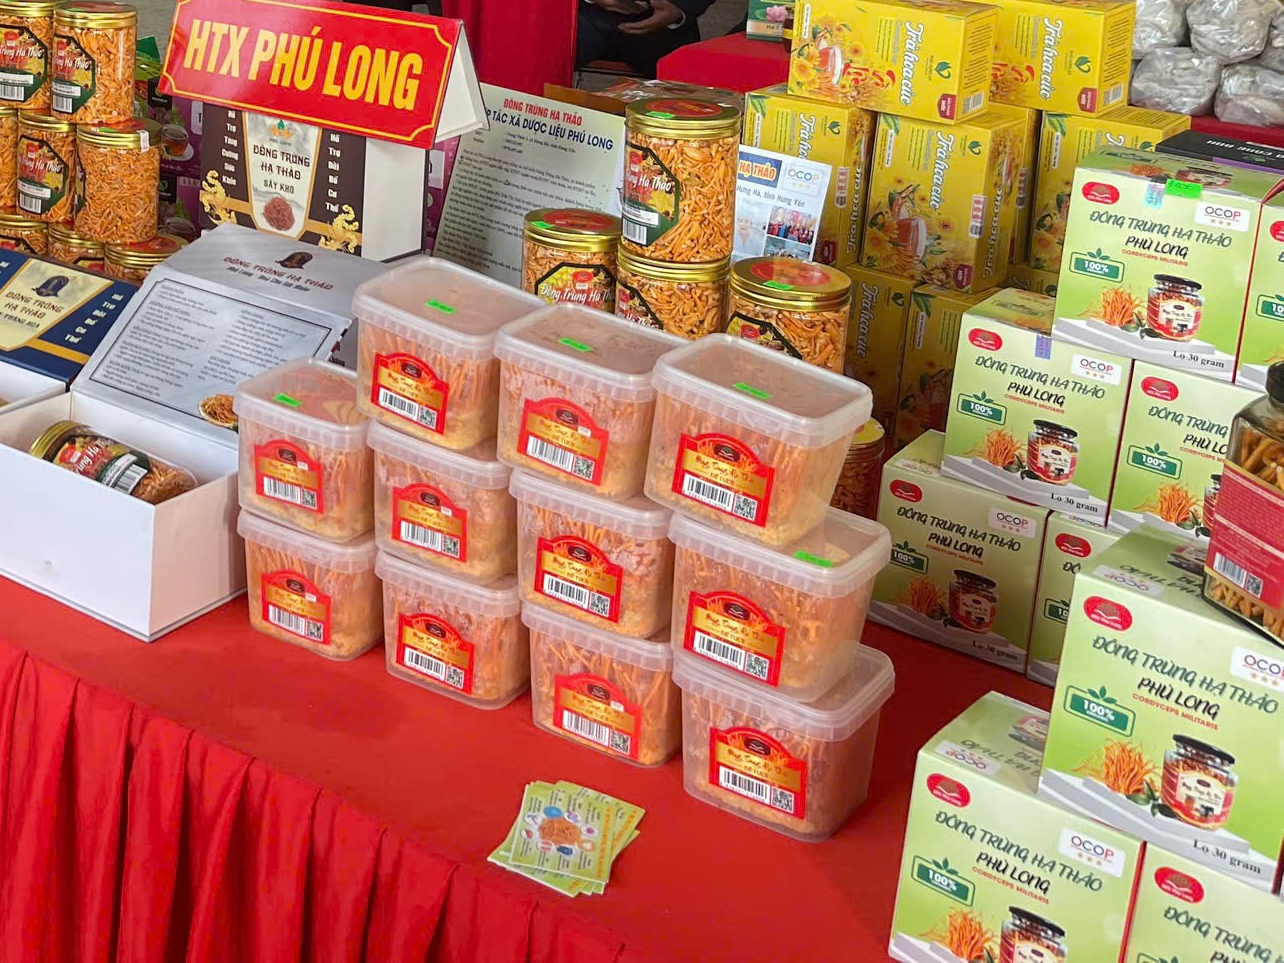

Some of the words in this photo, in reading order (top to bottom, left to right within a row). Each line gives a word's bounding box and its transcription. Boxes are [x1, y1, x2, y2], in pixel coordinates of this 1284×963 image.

[904, 20, 925, 50] Trà
[1042, 17, 1064, 46] Trà
[183, 18, 250, 78] HTX
[248, 27, 322, 91] PHÚ
[322, 40, 424, 112] LONG
[503, 98, 523, 113] ĐÔNG
[524, 103, 549, 118] TRÙNG
[550, 108, 561, 121] HẠ
[562, 110, 583, 127] THẢO
[492, 110, 508, 124] TÁC
[509, 114, 521, 128] XÃ
[522, 117, 547, 136] DƯỢC
[548, 123, 567, 141] LIỆU
[568, 127, 585, 144] PHÚ
[587, 134, 614, 151] LONG
[253, 144, 278, 160] ĐÔNG
[280, 150, 310, 168] TRÙNG
[934, 131, 956, 160] Trà
[260, 161, 274, 176] HẠ
[276, 164, 302, 180] THẢO
[739, 159, 752, 177] HẠ
[752, 162, 778, 183] THẢO
[787, 167, 820, 183] OCOP
[1204, 205, 1241, 221] OCOP
[1089, 210, 1124, 229] ĐÔNG
[1127, 214, 1171, 238] TRÙNG
[1172, 226, 1194, 242] HẠ
[1194, 230, 1233, 248] THẢO
[1154, 240, 1189, 259] LONG
[1084, 260, 1109, 273] 100%
[1079, 358, 1114, 373] OCOP
[1187, 353, 1199, 362] 30
[1200, 358, 1225, 369] gram
[974, 355, 1009, 373] ĐÔNG
[1010, 363, 1048, 385] TRÙNG
[1049, 376, 1070, 390] HẠ
[1071, 380, 1106, 399] THẢO
[969, 402, 994, 415] 100%
[1034, 388, 1066, 408] LONG
[1148, 405, 1184, 424] ĐÔNG
[1184, 415, 1229, 436] TRÙNG
[1140, 453, 1167, 469] 100%
[1063, 496, 1075, 506] 30
[1075, 500, 1098, 513] gram
[896, 506, 928, 525] ĐÔNG
[929, 515, 967, 537] TRÙNG
[988, 533, 1022, 552] THẢO
[996, 512, 1029, 527] OCOP
[891, 549, 916, 565] 100%
[953, 539, 985, 559] LONG
[1141, 650, 1200, 687] TRÙNG
[1200, 675, 1227, 699] HẠ
[1228, 683, 1280, 715] THẢO
[1082, 698, 1116, 722] 100%
[1131, 692, 1181, 718] CORDYCEPS
[1180, 710, 1220, 731] MILITARIS
[1175, 689, 1222, 720] LONG
[1070, 835, 1115, 860] OCOP
[1030, 852, 1056, 875] HẠ
[1057, 862, 1104, 893] THẢO
[1211, 847, 1227, 860] 30
[1229, 855, 1262, 875] gram
[927, 867, 958, 891] 100%
[1010, 864, 1052, 895] LONG
[1163, 905, 1212, 939] ĐÔNG
